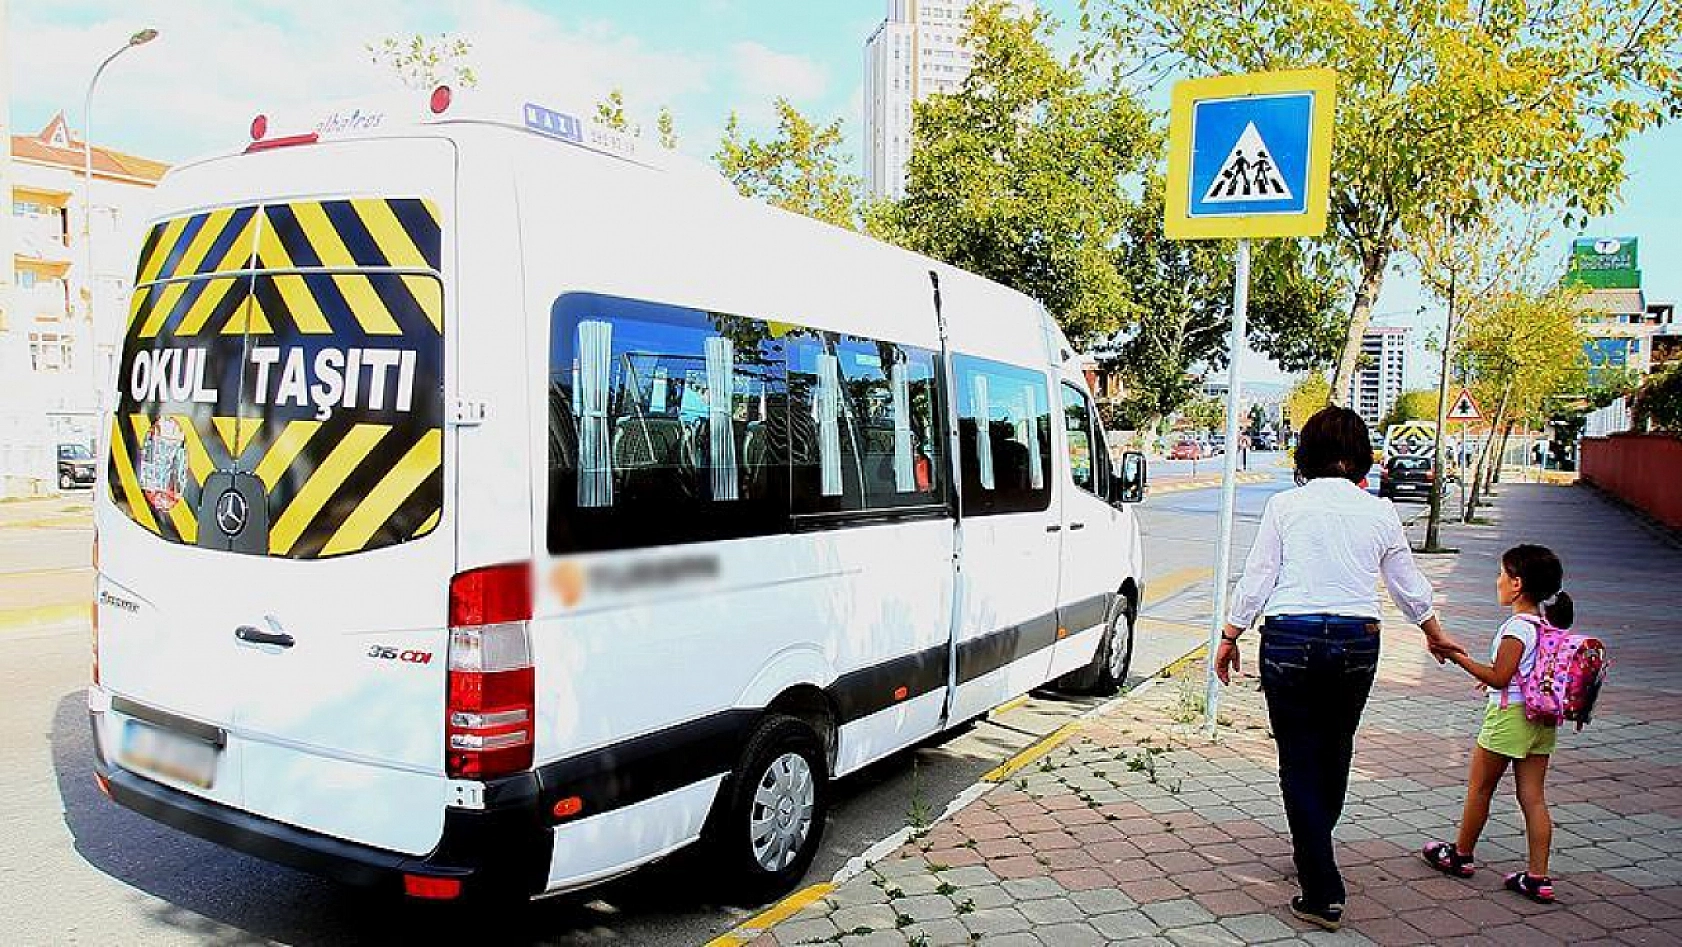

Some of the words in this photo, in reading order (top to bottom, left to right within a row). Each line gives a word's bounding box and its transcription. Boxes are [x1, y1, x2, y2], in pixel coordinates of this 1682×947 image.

[131, 348, 218, 403] OKUL
[250, 347, 418, 421] TAŞITI
[400, 649, 432, 664] CDI
